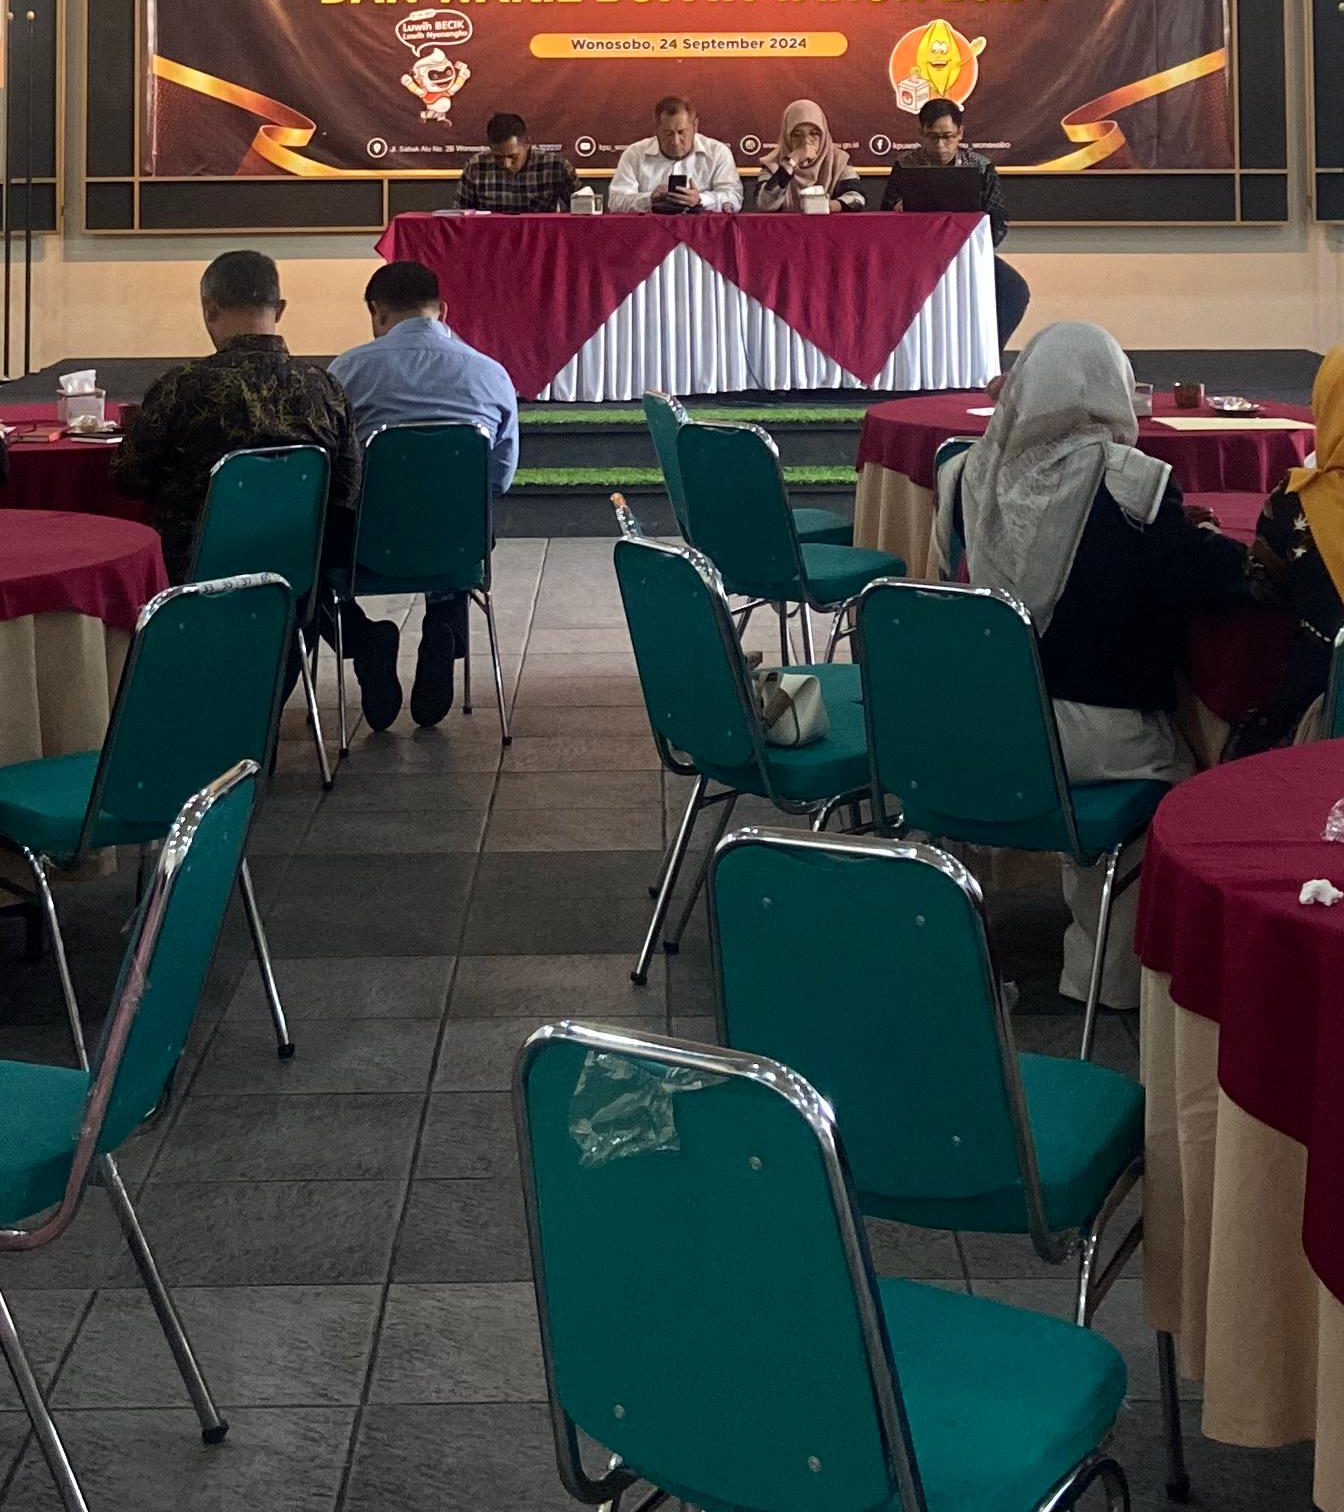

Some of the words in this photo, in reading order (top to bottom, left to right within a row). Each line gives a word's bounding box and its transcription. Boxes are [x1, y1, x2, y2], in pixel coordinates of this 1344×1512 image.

[435, 20, 465, 31] BECIK
[571, 38, 655, 51] Wonosobo,
[659, 38, 678, 50] 24
[683, 37, 765, 52] September
[769, 37, 807, 49] 2024
